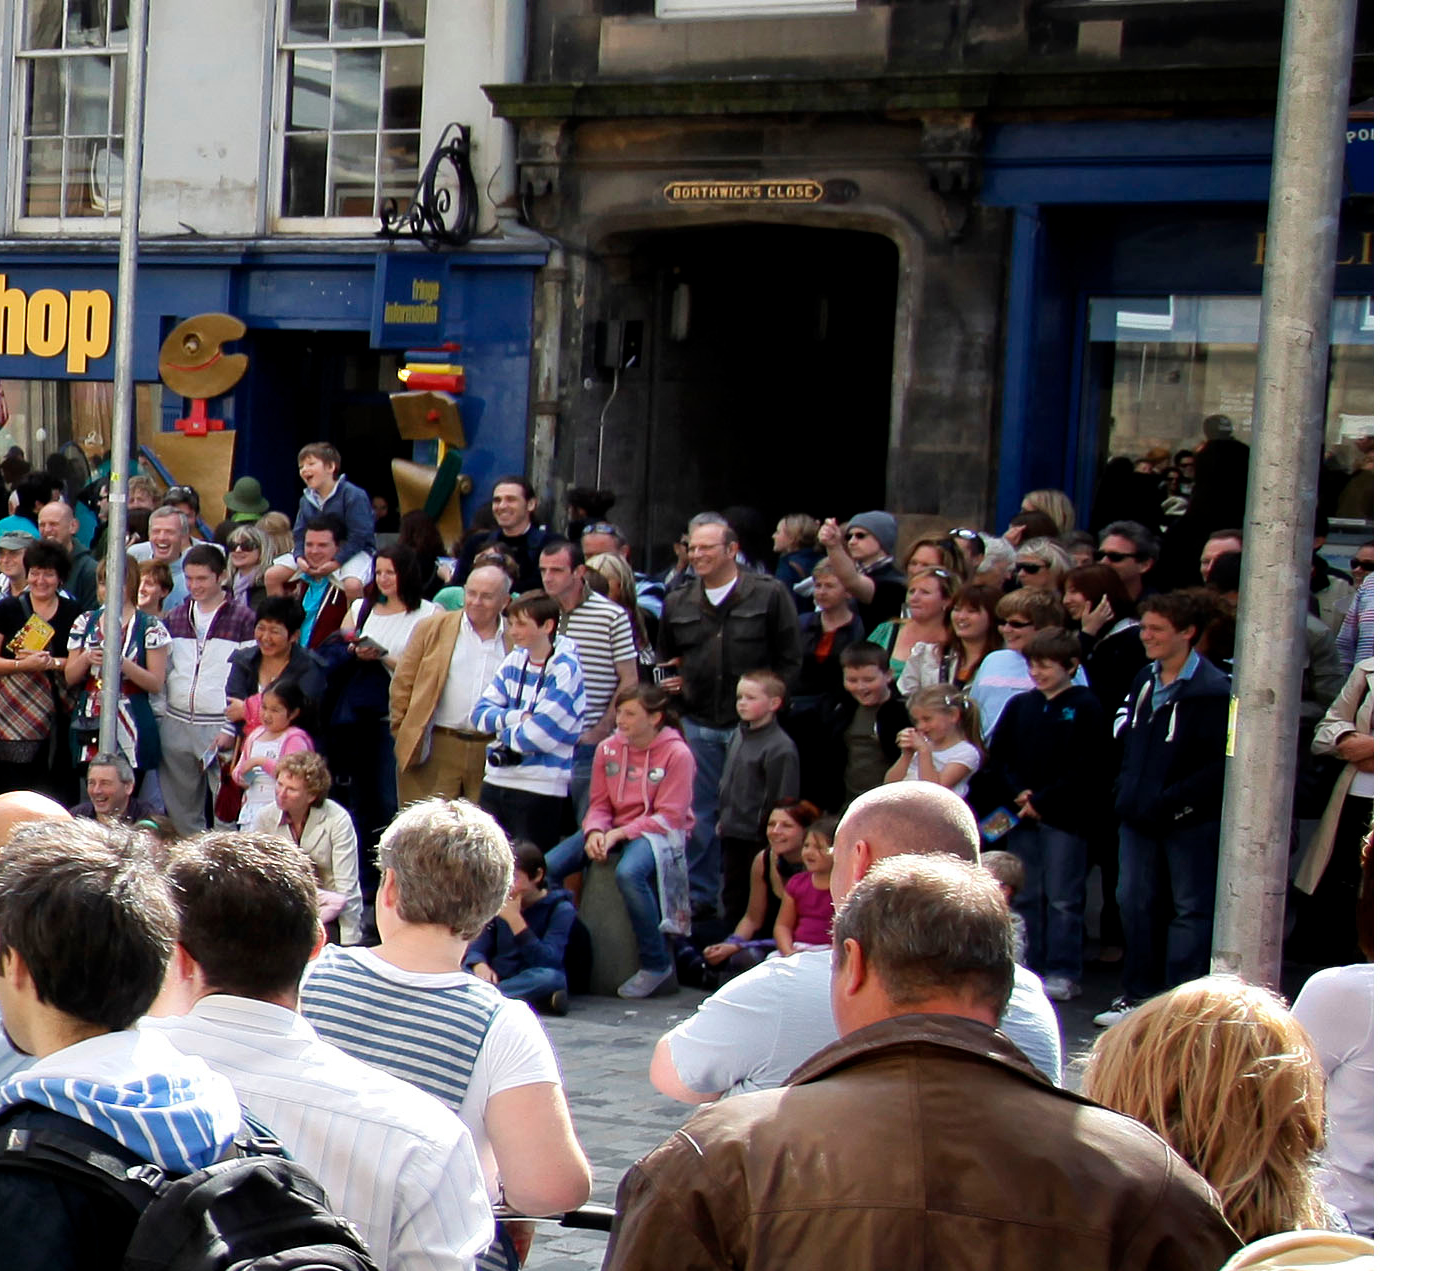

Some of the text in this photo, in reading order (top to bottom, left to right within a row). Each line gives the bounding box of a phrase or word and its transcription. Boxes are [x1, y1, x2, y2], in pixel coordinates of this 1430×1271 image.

[672, 185, 815, 200] BORTHWICK'S CLOSE
[412, 278, 440, 305] fringe
[384, 301, 438, 324] information
